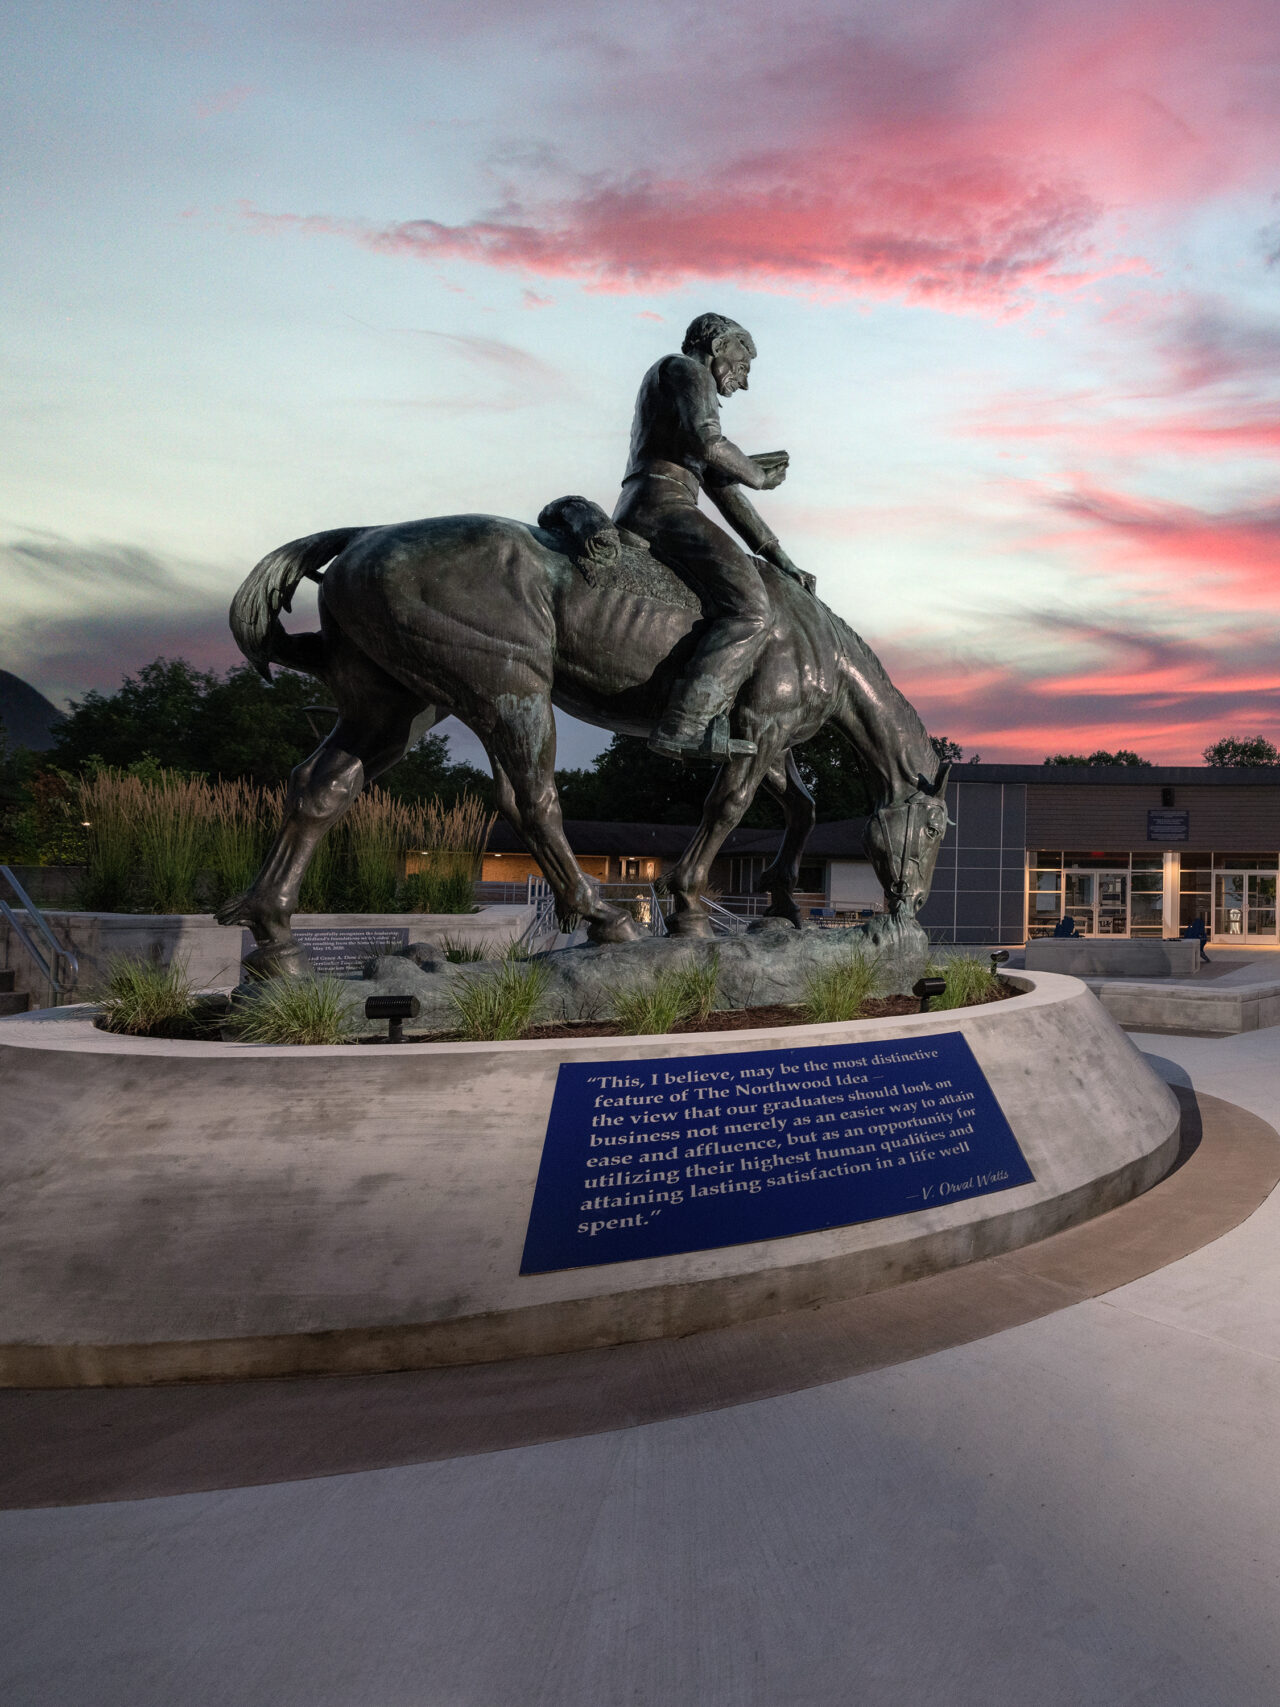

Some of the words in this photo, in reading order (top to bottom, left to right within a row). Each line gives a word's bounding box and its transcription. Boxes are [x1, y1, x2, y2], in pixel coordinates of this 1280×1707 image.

[587, 1075, 645, 1089] “This,
[651, 1073, 658, 1086] I
[664, 1070, 735, 1085] believe,
[740, 1067, 775, 1079] may
[780, 1063, 799, 1074] be
[803, 1060, 828, 1072] the
[832, 1057, 868, 1069] most
[871, 1049, 938, 1065] distinctive
[594, 1094, 664, 1108] feature
[669, 1088, 689, 1102] of
[693, 1087, 730, 1100] The
[735, 1076, 832, 1096] Northwood
[836, 1074, 869, 1086] Idea
[590, 1131, 680, 1147] business
[686, 1124, 719, 1139] not
[724, 1116, 787, 1134] merely
[793, 1116, 811, 1126] as
[816, 1113, 836, 1123] an
[840, 1105, 885, 1120] easier
[889, 1102, 917, 1114] way
[921, 1099, 935, 1108] to
[939, 1091, 975, 1105] attain
[592, 1113, 624, 1127] the
[630, 1111, 679, 1124] view
[684, 1105, 722, 1120] that
[726, 1104, 758, 1115] our
[763, 1094, 844, 1115] graduates
[848, 1085, 899, 1101] should
[901, 1081, 933, 1094] look
[935, 1080, 952, 1089] on
[584, 1169, 680, 1189] utilizing
[685, 1160, 735, 1178] their
[740, 1151, 811, 1172] highest
[816, 1144, 877, 1160] human
[880, 1131, 946, 1153] qualities
[949, 1123, 974, 1138] and
[586, 1155, 633, 1168] ease
[639, 1146, 679, 1163] and
[684, 1139, 782, 1158] affluence,
[786, 1131, 817, 1145] but
[822, 1130, 840, 1141] as
[844, 1127, 865, 1138] an
[868, 1112, 953, 1136] opportunity
[956, 1107, 976, 1119] for
[580, 1189, 684, 1211] attaining
[690, 1179, 762, 1198] lasting
[766, 1163, 872, 1187] satisfaction
[876, 1157, 893, 1169] in
[898, 1157, 906, 1166] a
[909, 1149, 935, 1163] life
[939, 1141, 970, 1157] well
[939, 1177, 975, 1196] Orval
[976, 1169, 1009, 1188] Watts
[577, 1209, 661, 1236] spent.”
